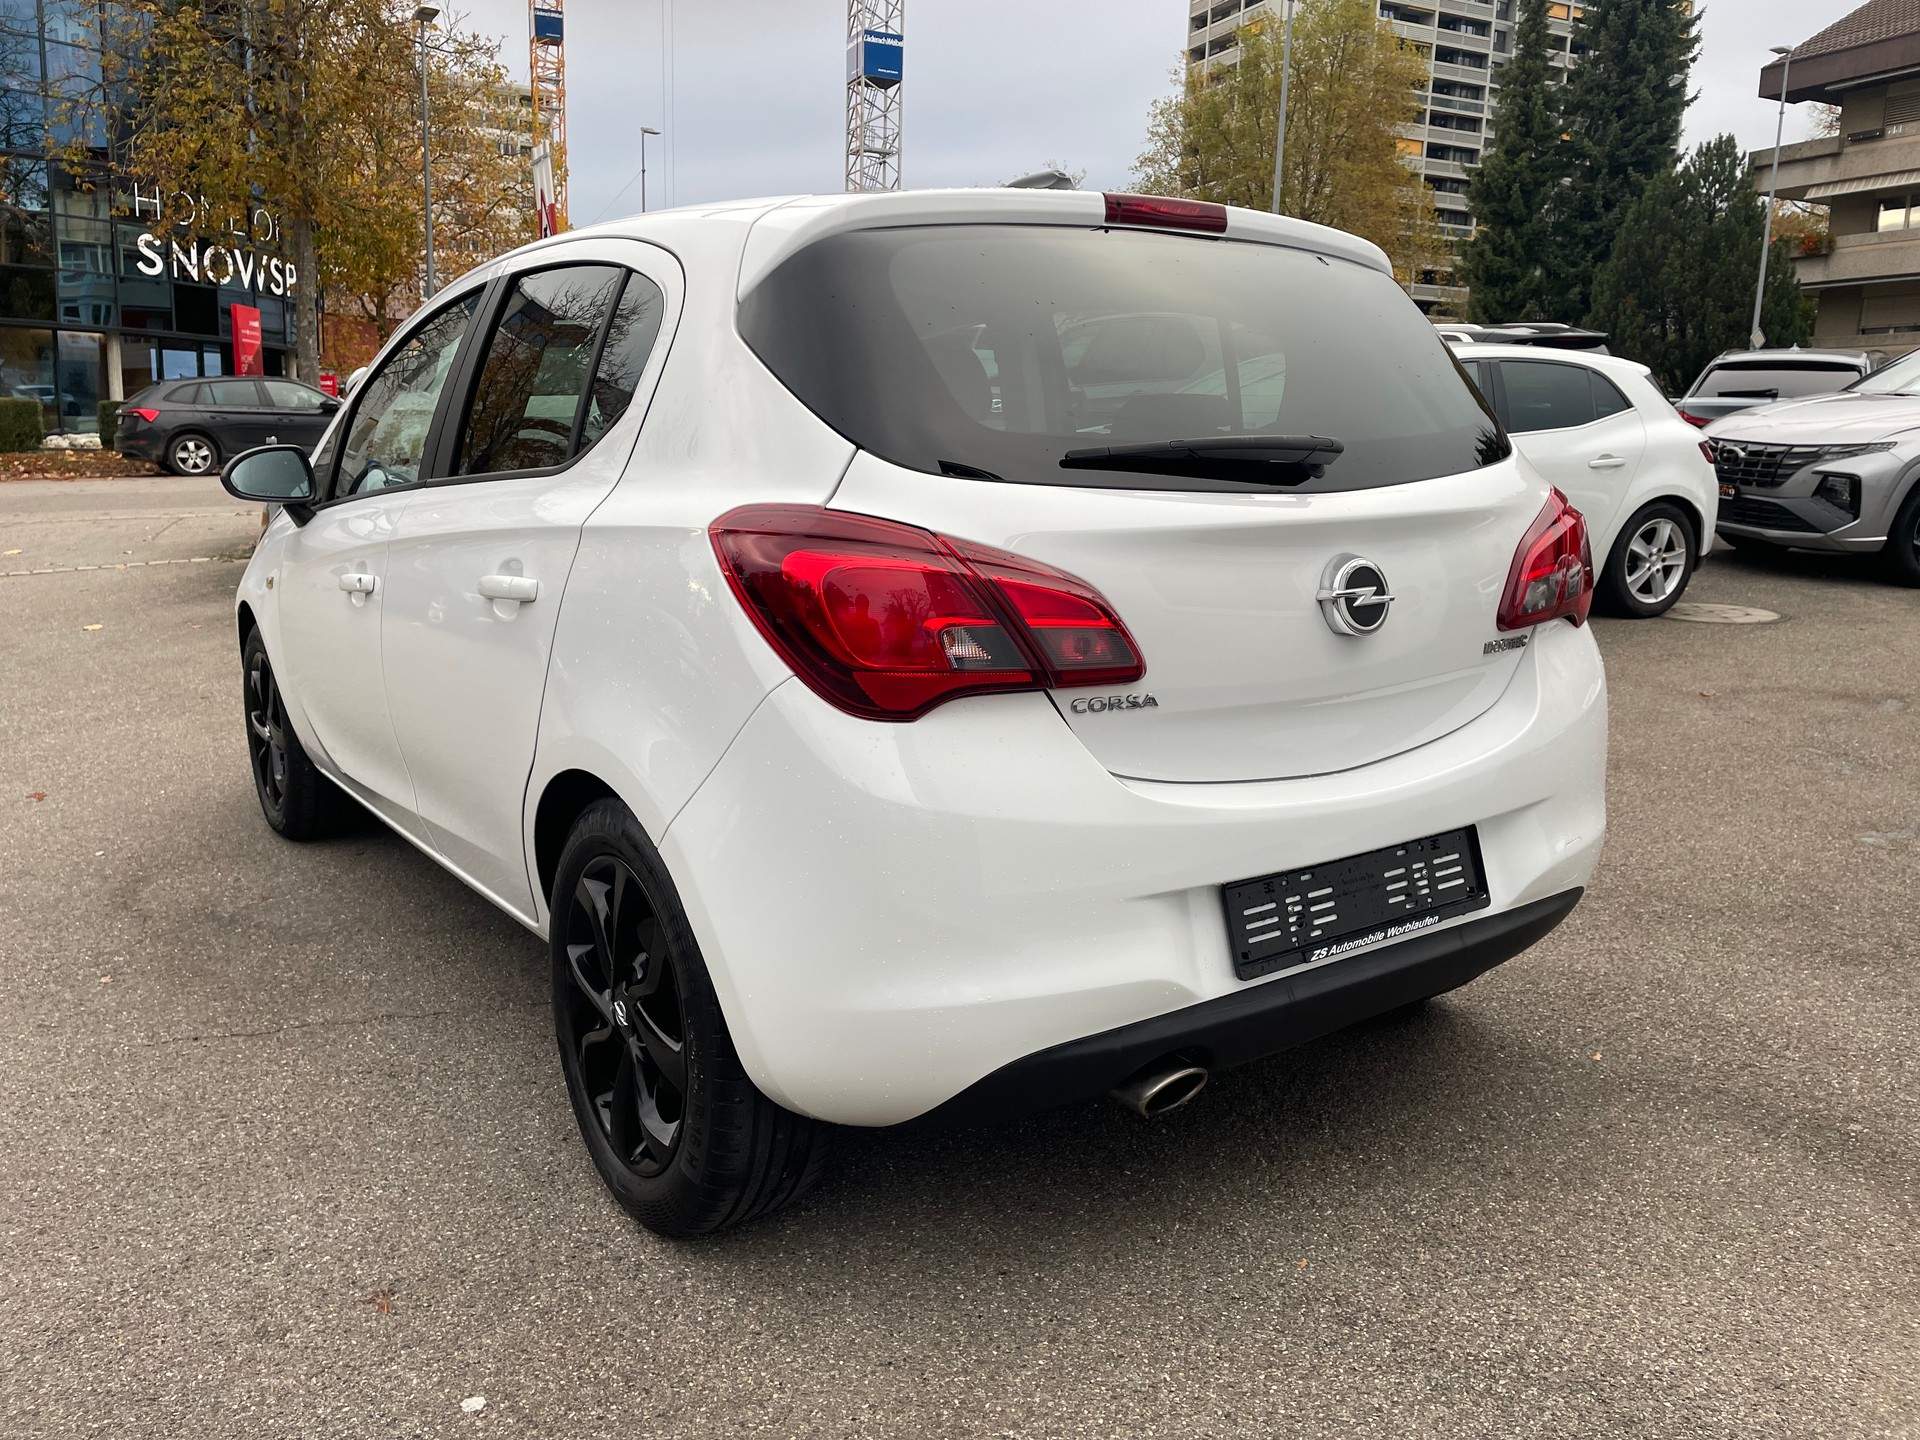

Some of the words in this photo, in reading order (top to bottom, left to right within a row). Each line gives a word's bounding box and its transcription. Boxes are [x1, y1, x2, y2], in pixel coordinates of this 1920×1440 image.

[1070, 692, 1159, 714] CORSA
[1310, 947, 1329, 961] ZS
[1328, 931, 1385, 956] Automobile
[1386, 915, 1439, 938] Worblaufen
